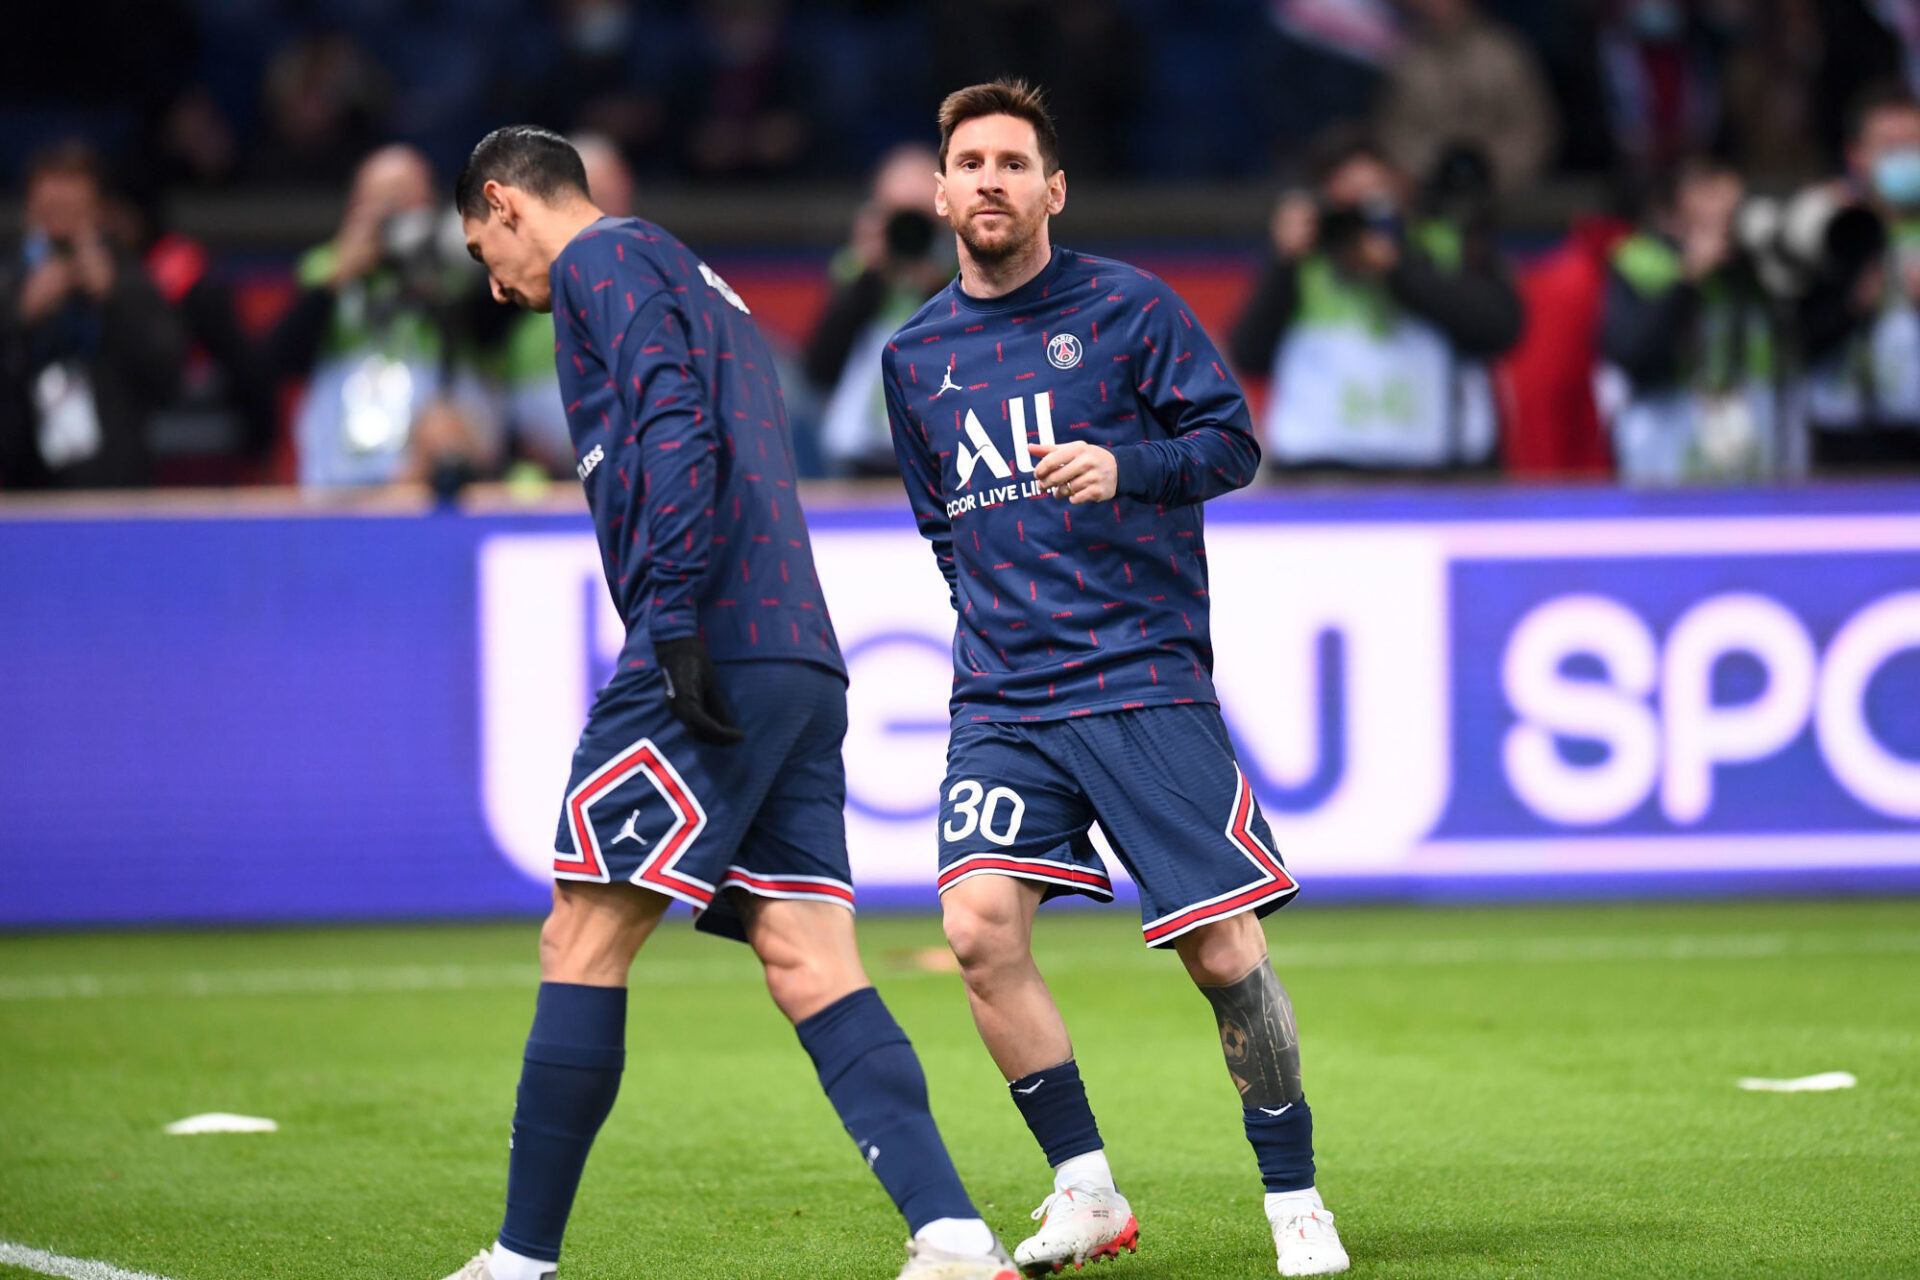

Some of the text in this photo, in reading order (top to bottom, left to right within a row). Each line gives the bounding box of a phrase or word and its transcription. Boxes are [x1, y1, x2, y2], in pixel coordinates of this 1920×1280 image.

[1051, 335, 1074, 347] PARIS
[946, 494, 977, 520] CCOR
[978, 484, 1019, 507] LIVE
[943, 780, 1026, 846] 30
